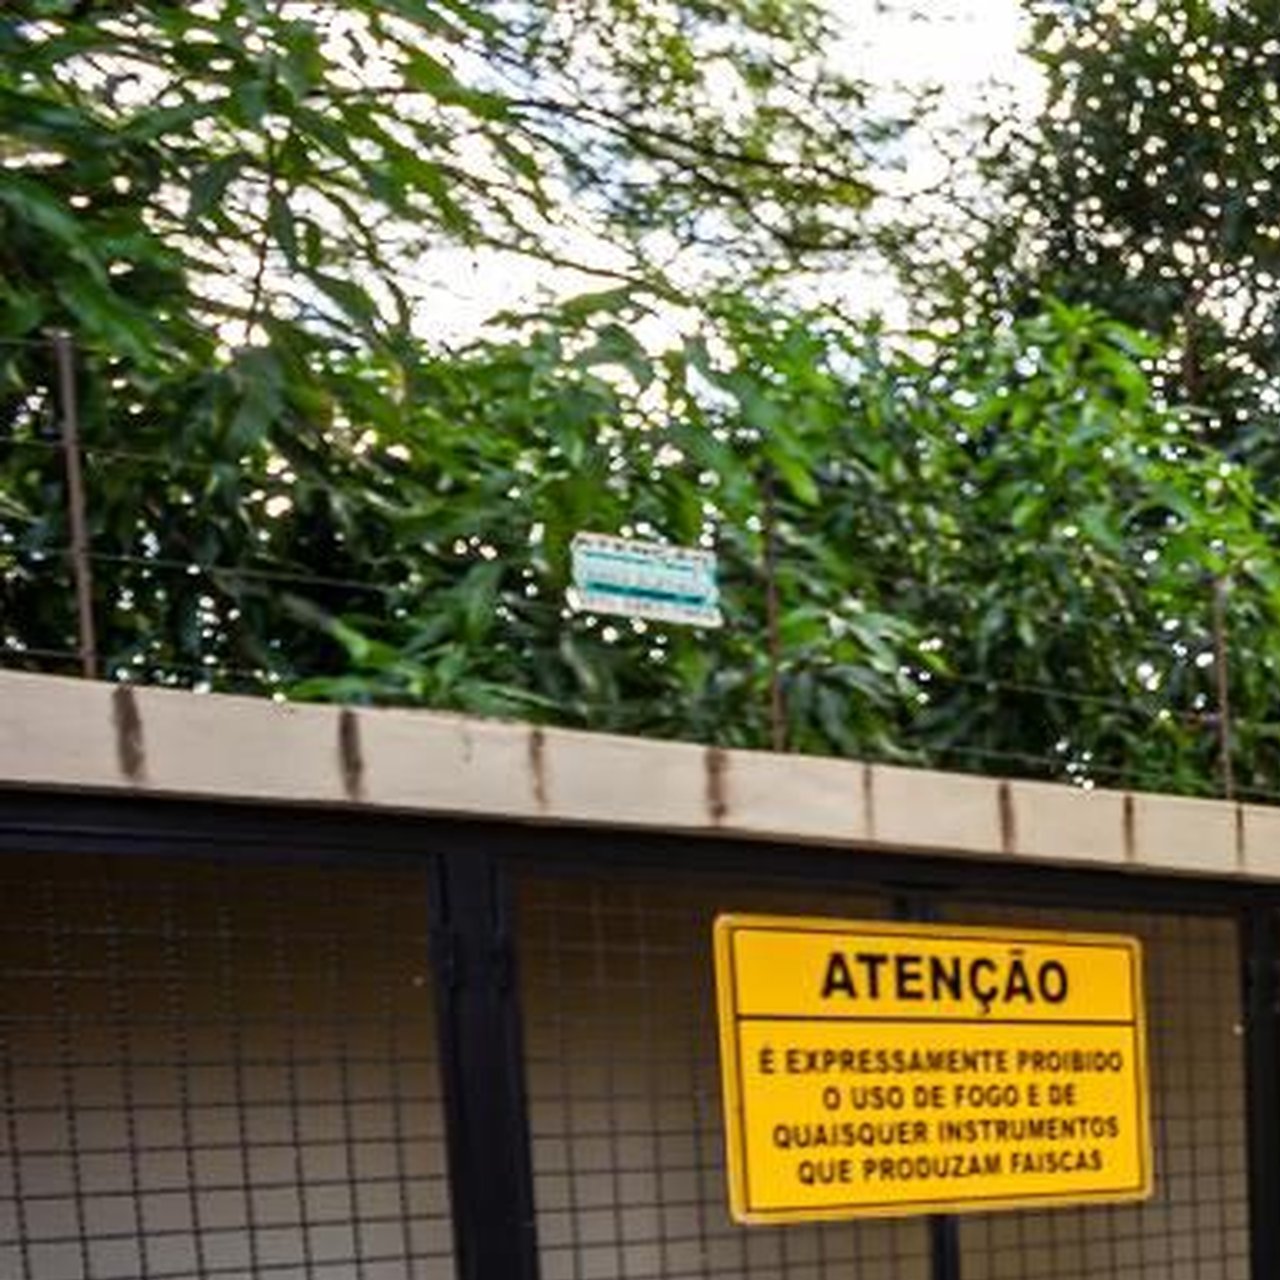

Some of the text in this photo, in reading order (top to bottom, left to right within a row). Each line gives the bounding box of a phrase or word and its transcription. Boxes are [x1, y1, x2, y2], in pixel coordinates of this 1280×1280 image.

[821, 949, 1068, 1014] ATENÇÃO
[785, 1048, 1007, 1074] EXPRESSAMENTE
[1017, 1050, 1122, 1073] PROIBIDO
[823, 1083, 1076, 1110] O USO DE FOGO E DE
[773, 1115, 1119, 1149] QUAISQUER INSTRUMENTOS
[799, 1158, 852, 1184] QUE
[863, 1154, 1001, 1182] PRODUZAM
